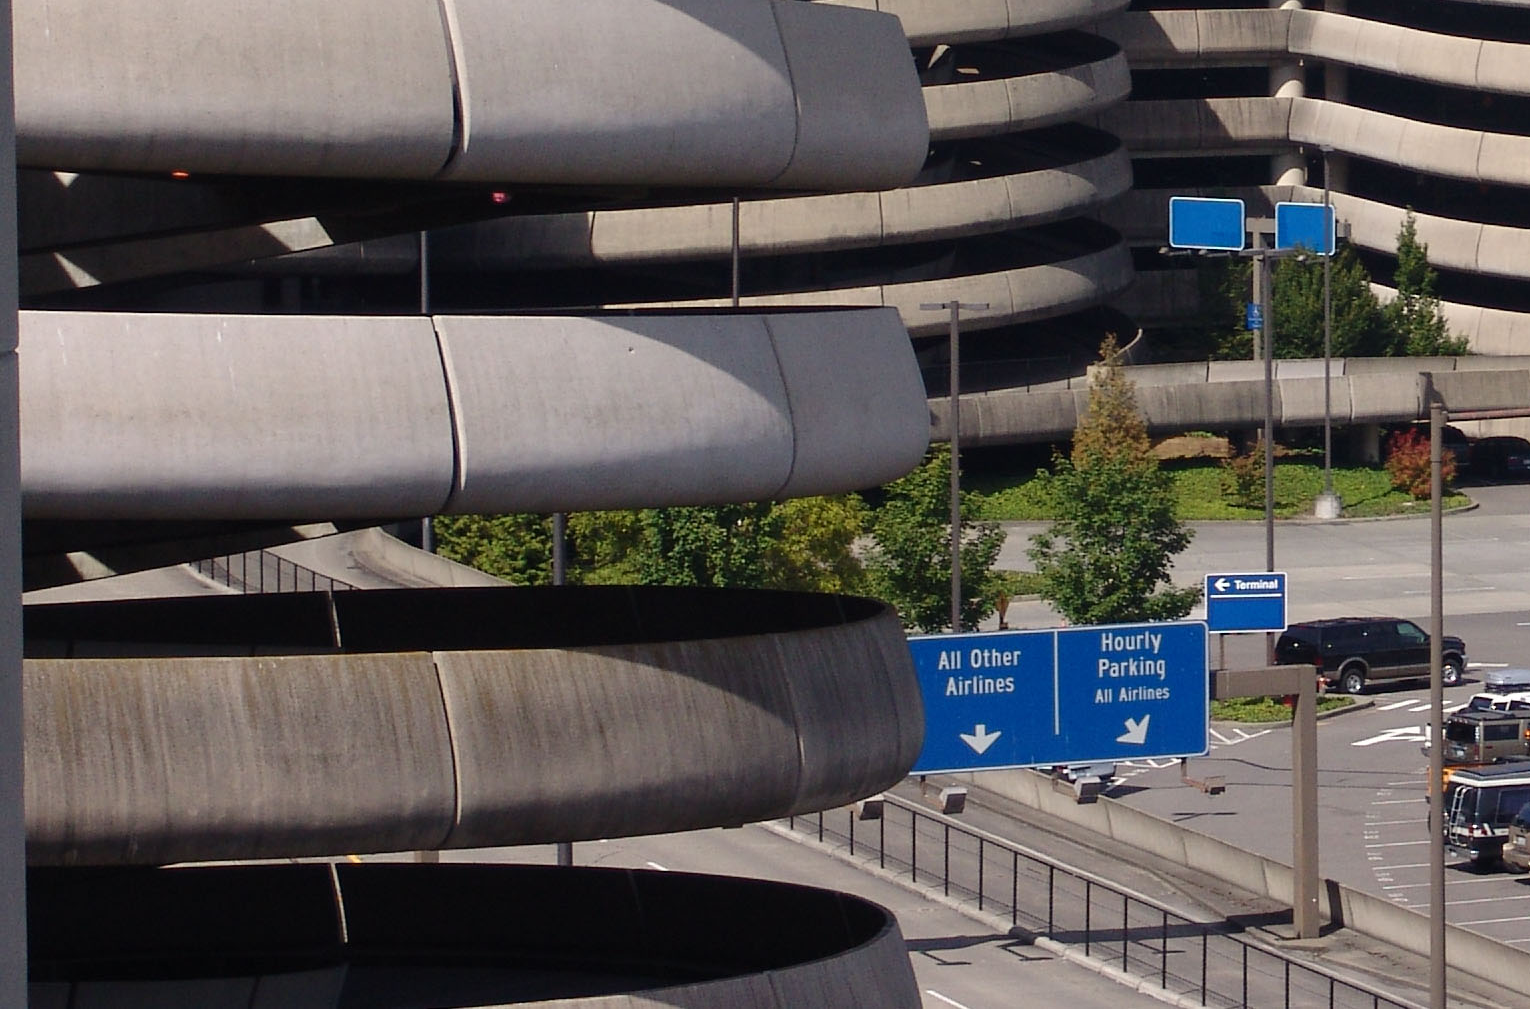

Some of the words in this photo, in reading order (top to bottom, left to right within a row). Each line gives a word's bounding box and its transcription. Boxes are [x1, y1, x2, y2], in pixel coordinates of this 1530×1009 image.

[1233, 578, 1279, 590] Terminal
[1101, 632, 1162, 655] Hourly
[938, 650, 961, 670] All
[970, 648, 1021, 668] Other
[1098, 657, 1166, 680] Parking
[945, 676, 1015, 696] Airlines
[1095, 688, 1112, 704] All
[1118, 686, 1170, 702] Airlines
